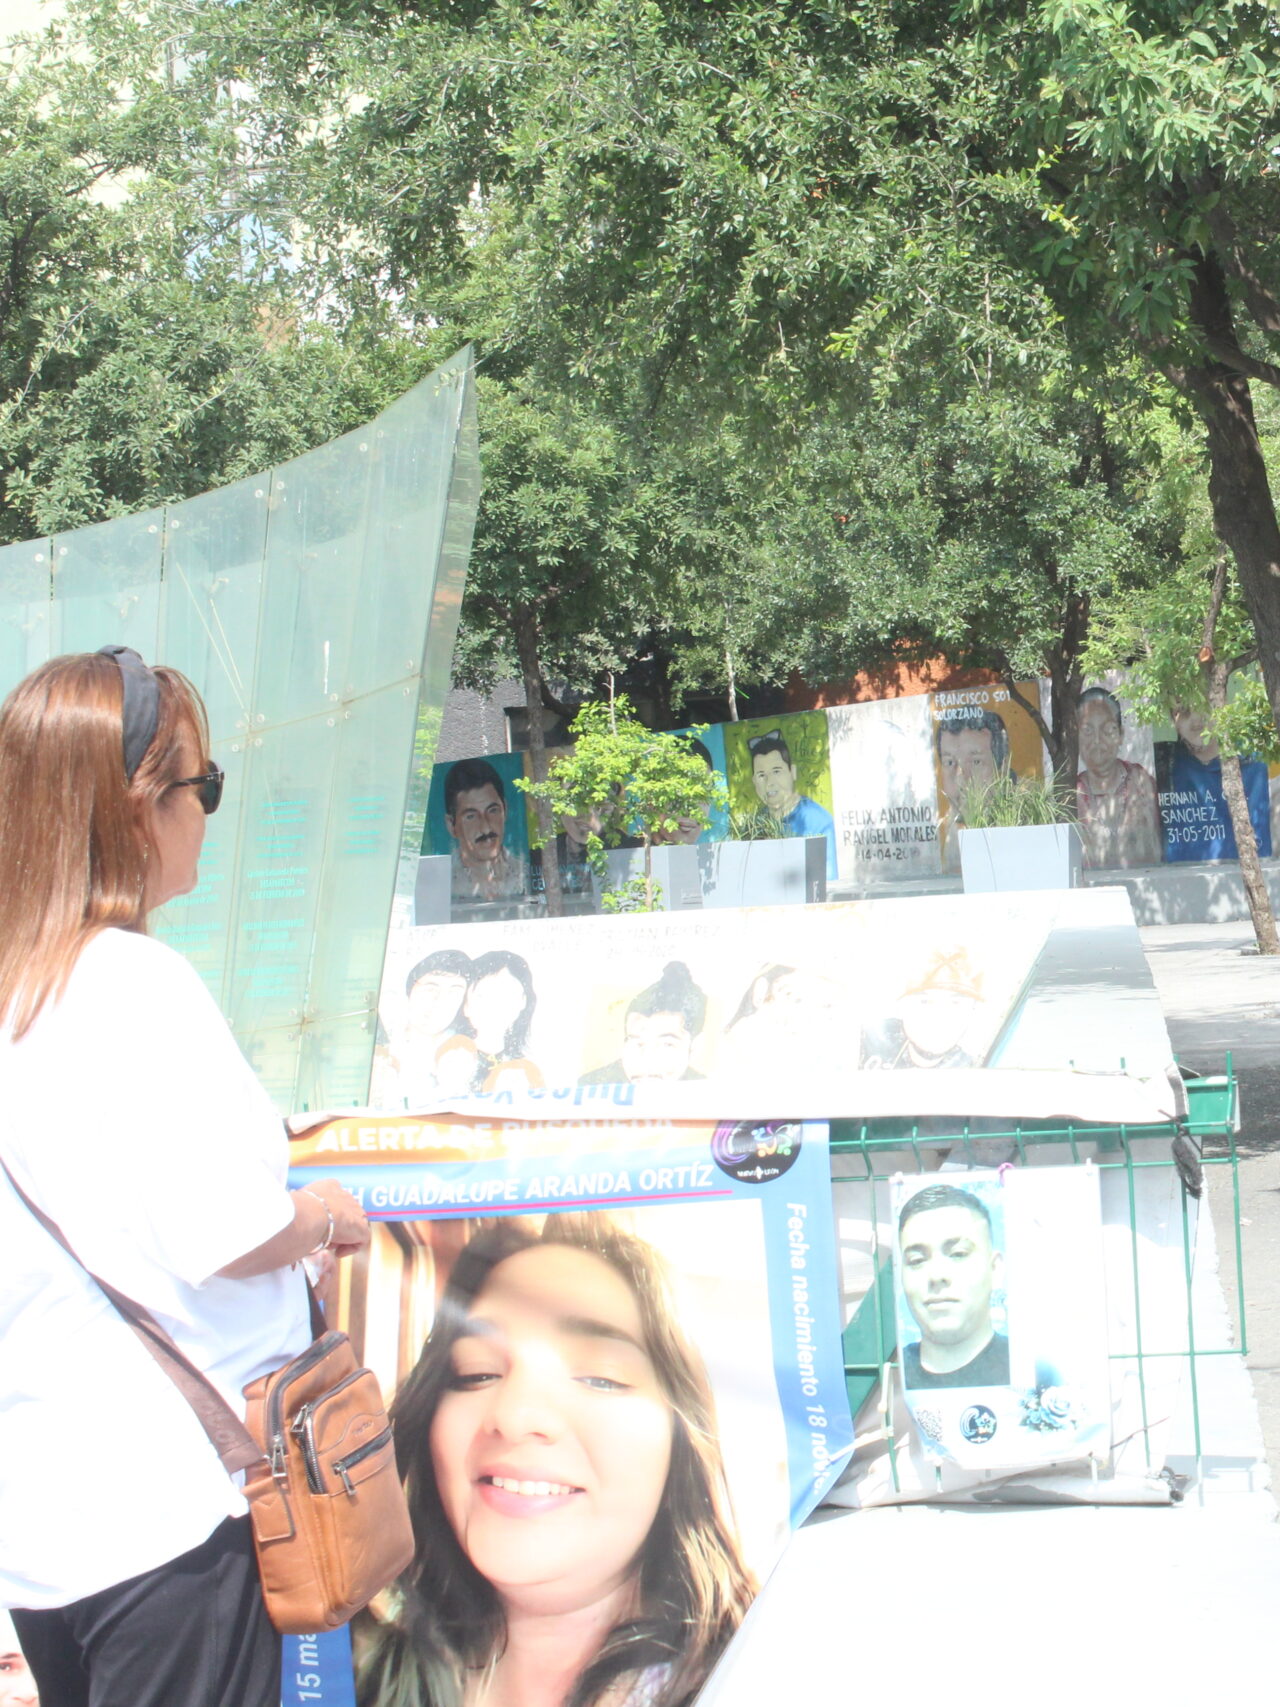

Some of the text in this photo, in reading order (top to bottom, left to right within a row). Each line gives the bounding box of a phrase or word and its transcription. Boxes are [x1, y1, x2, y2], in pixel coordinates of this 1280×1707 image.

[935, 690, 990, 708] FRANCISCO
[933, 706, 984, 721] SOLORZANO
[1158, 791, 1198, 806] HERNAN
[1204, 789, 1217, 804] A.
[841, 805, 932, 826] FELIX ANTONIO
[1161, 806, 1219, 824] SANCHEZ
[842, 825, 937, 847] RANGEL MORALES
[1167, 824, 1226, 844] 31-05-2011
[315, 1123, 441, 1153] ALERTA
[445, 1121, 494, 1150] DE
[371, 1177, 521, 1208] GUADALUPE
[525, 1170, 632, 1200] ARANDA
[638, 1159, 715, 1191] ORTÍZ
[786, 1202, 811, 1271] Fecha
[791, 1274, 818, 1398] nacimiento
[806, 1403, 828, 1428] 18
[296, 1672, 323, 1702] 15
